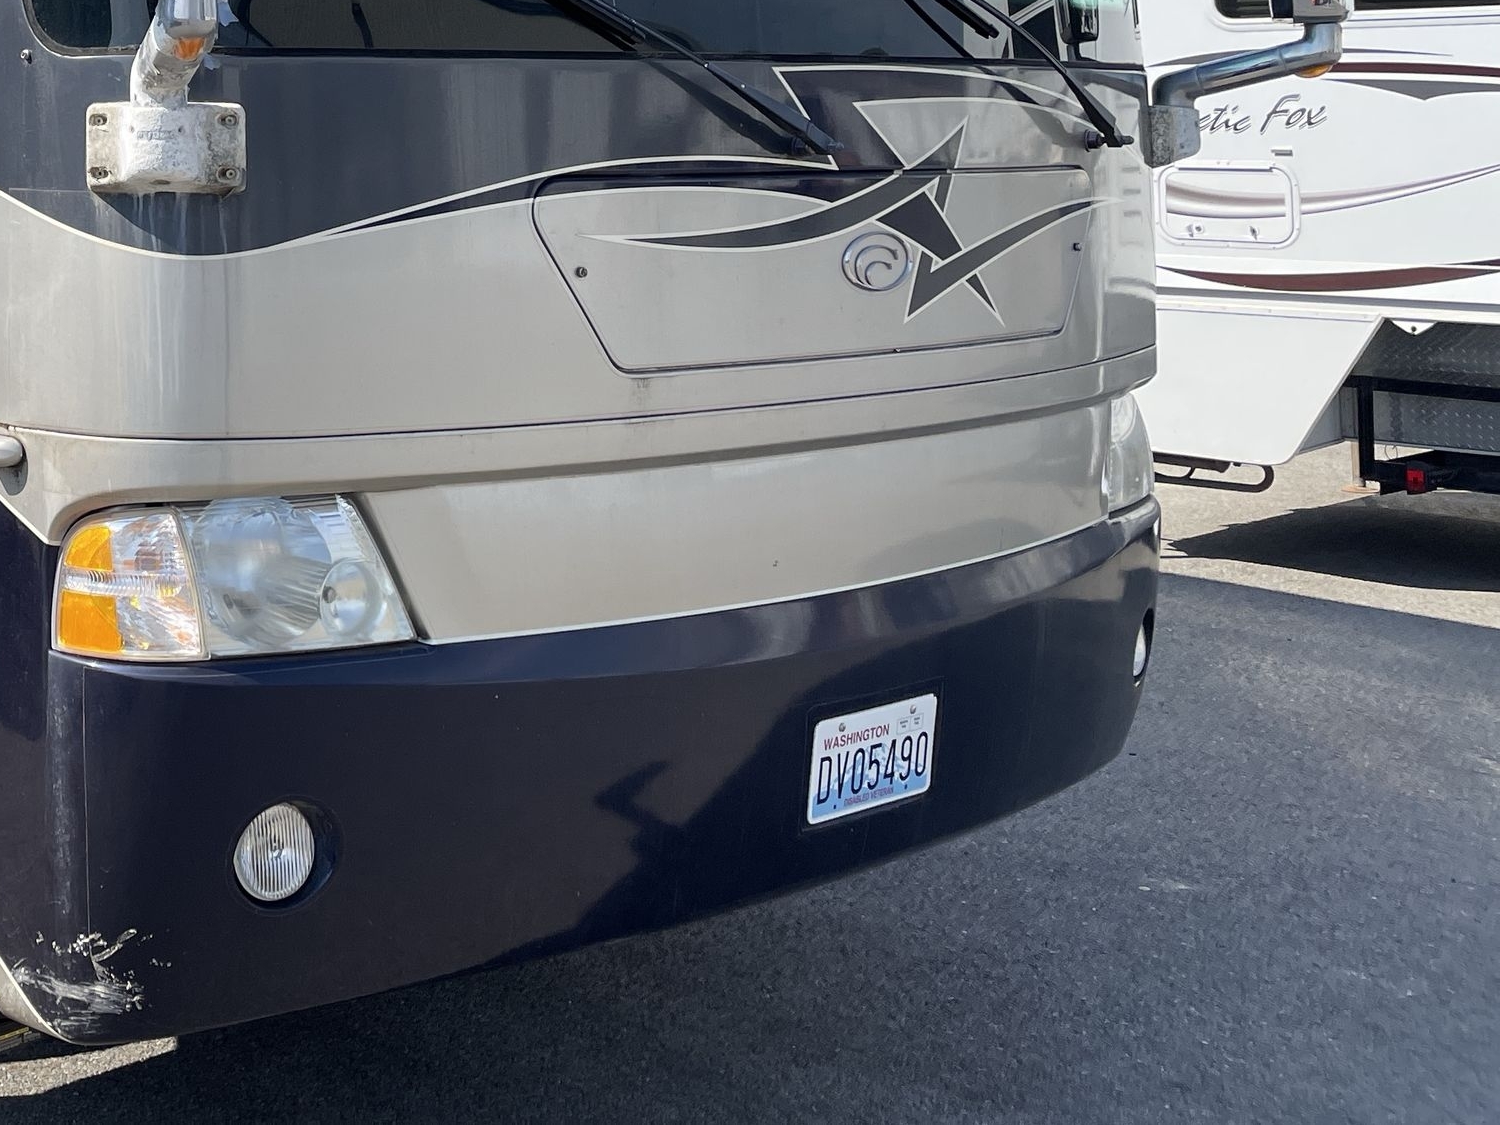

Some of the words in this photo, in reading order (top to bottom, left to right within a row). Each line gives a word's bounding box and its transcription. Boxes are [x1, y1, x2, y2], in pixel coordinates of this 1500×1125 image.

[1260, 94, 1327, 135] Fox
[823, 724, 890, 751] WASHINGTON
[817, 731, 928, 805] DV05490
